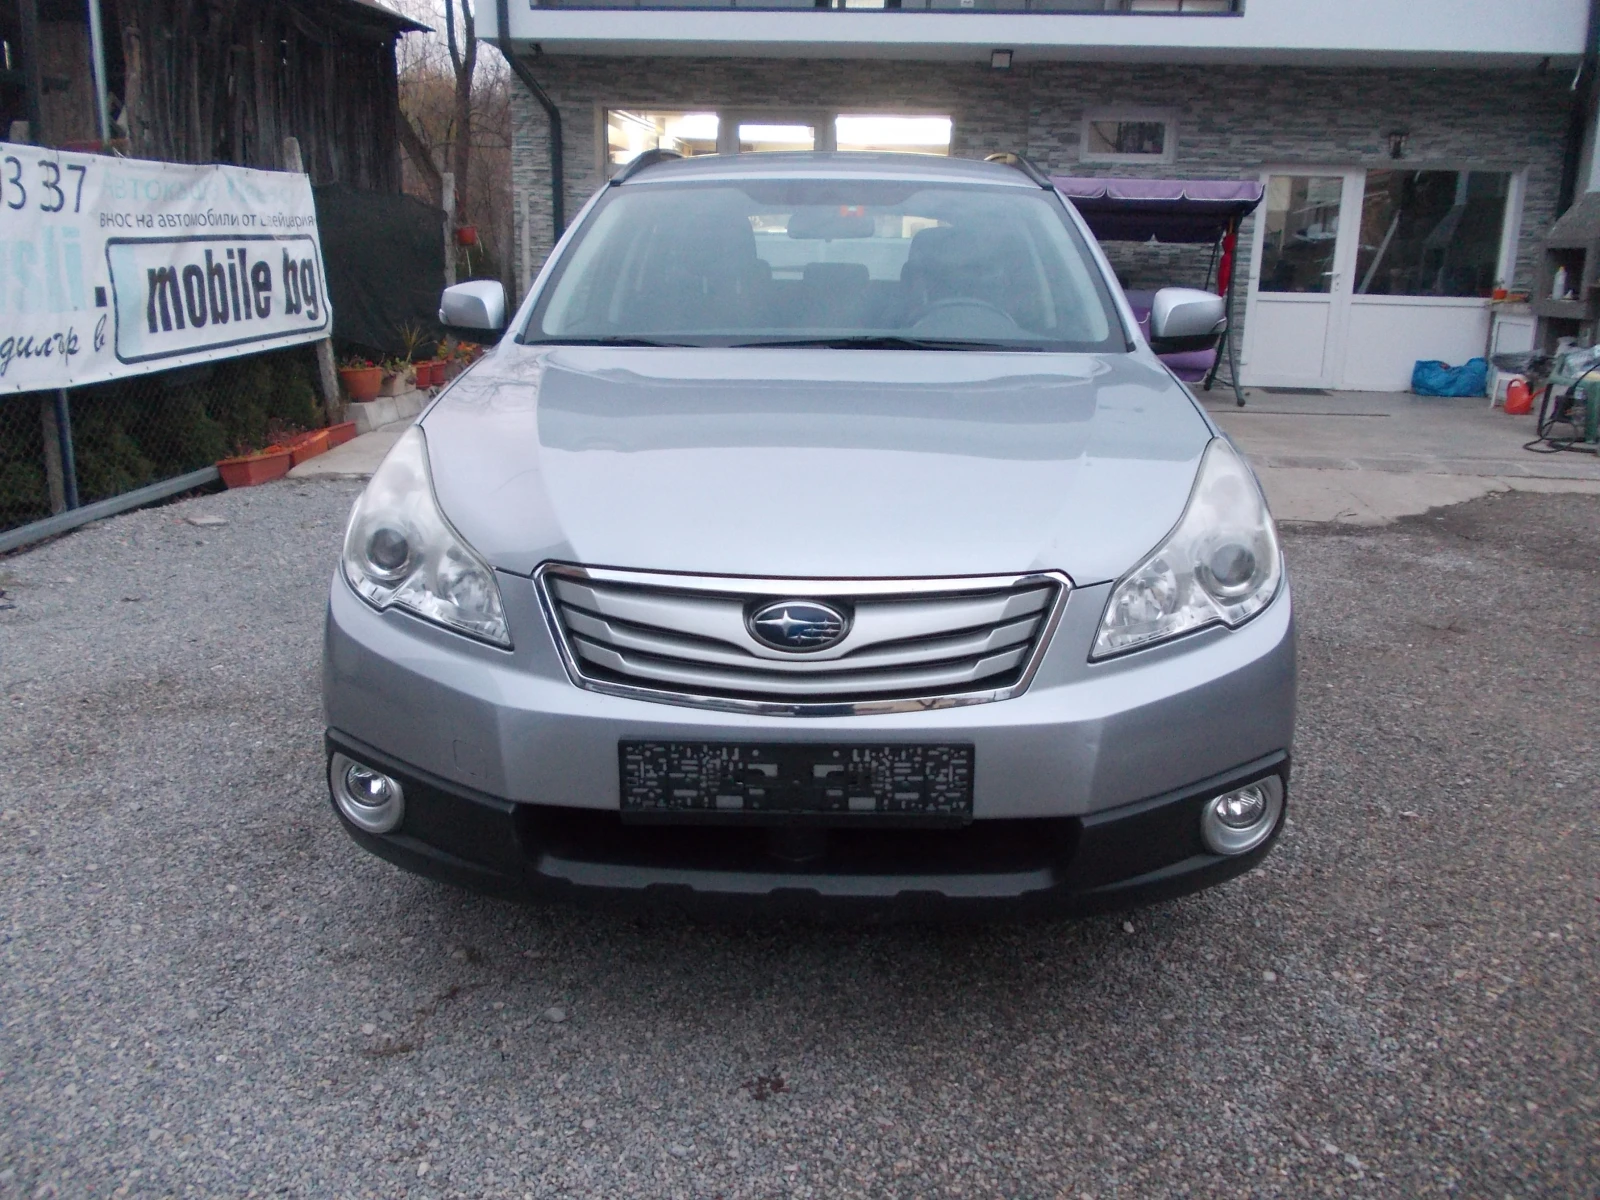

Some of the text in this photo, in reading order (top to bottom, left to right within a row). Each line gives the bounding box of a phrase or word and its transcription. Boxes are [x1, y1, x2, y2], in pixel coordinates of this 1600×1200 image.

[0, 155, 86, 213] 3 37
[136, 212, 153, 228] на
[159, 208, 240, 228] автомобили
[242, 213, 257, 227] от
[147, 247, 319, 333] mobile bg
